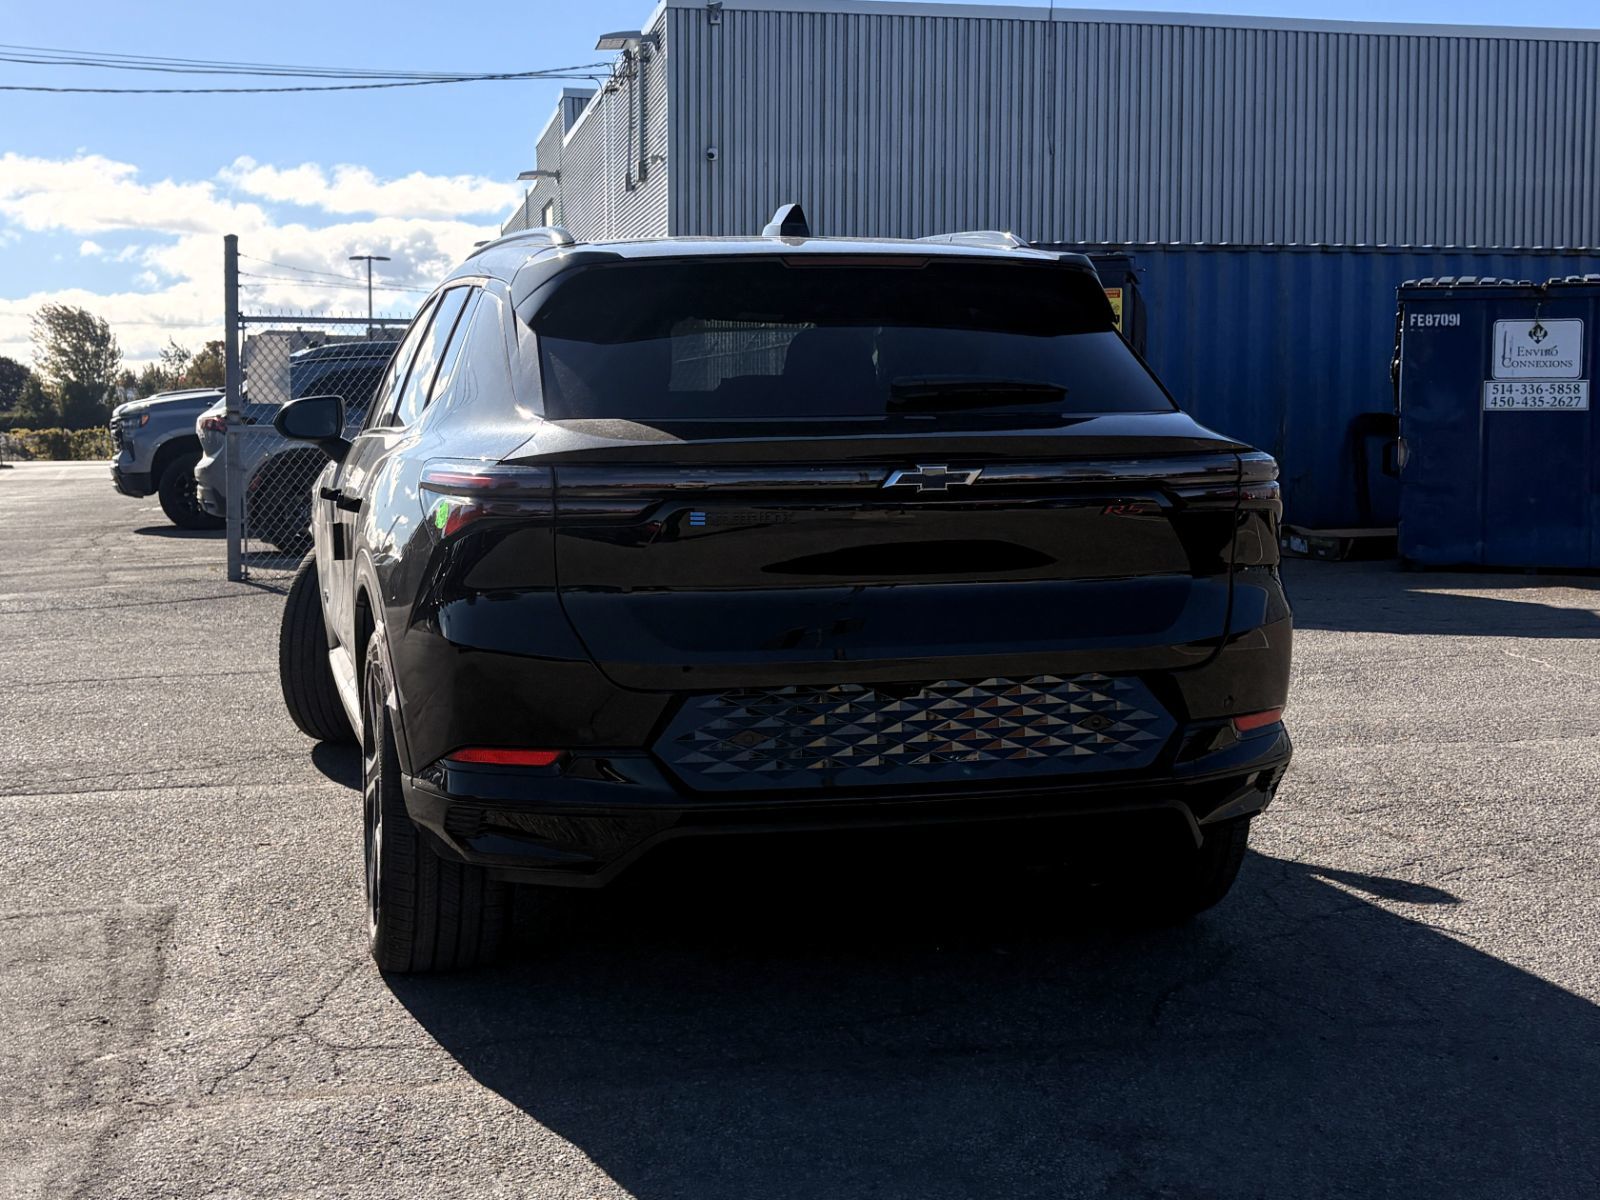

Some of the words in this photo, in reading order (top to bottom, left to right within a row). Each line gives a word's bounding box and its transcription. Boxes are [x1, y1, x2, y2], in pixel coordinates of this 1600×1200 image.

[1501, 357, 1573, 368] CONNEXIONS
[1492, 383, 1581, 395] 514-336-5858
[1490, 396, 1582, 408] 450-435-2627
